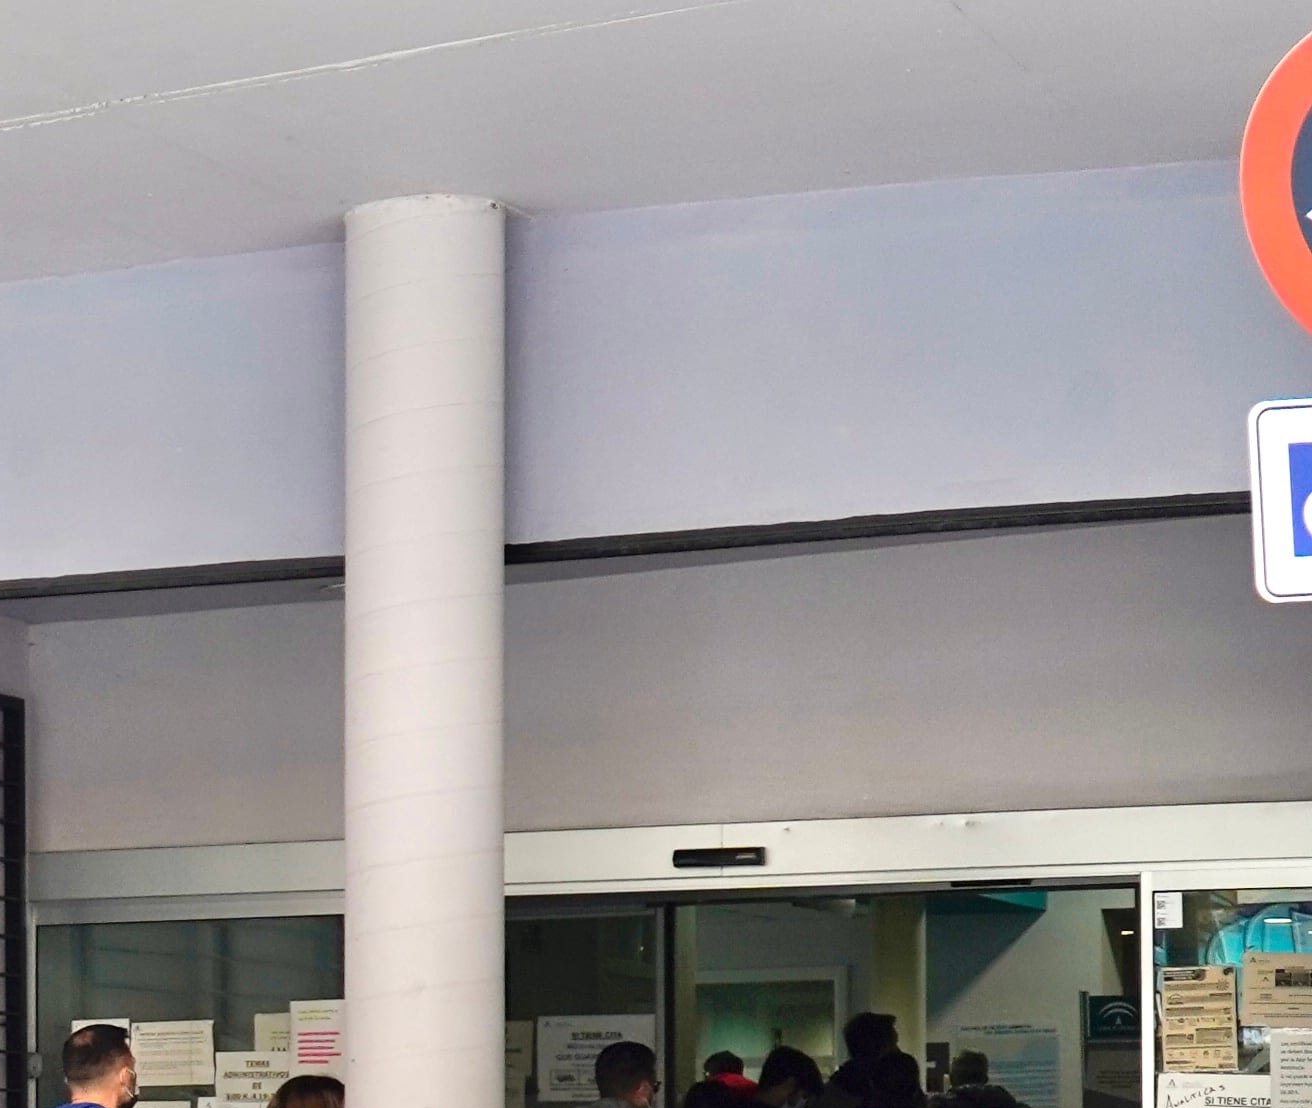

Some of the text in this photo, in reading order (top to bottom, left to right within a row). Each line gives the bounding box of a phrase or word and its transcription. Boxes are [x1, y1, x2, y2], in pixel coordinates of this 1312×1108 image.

[245, 1059, 270, 1068] TEMAS
[1204, 1096, 1272, 1106] SI TIENE CITA
